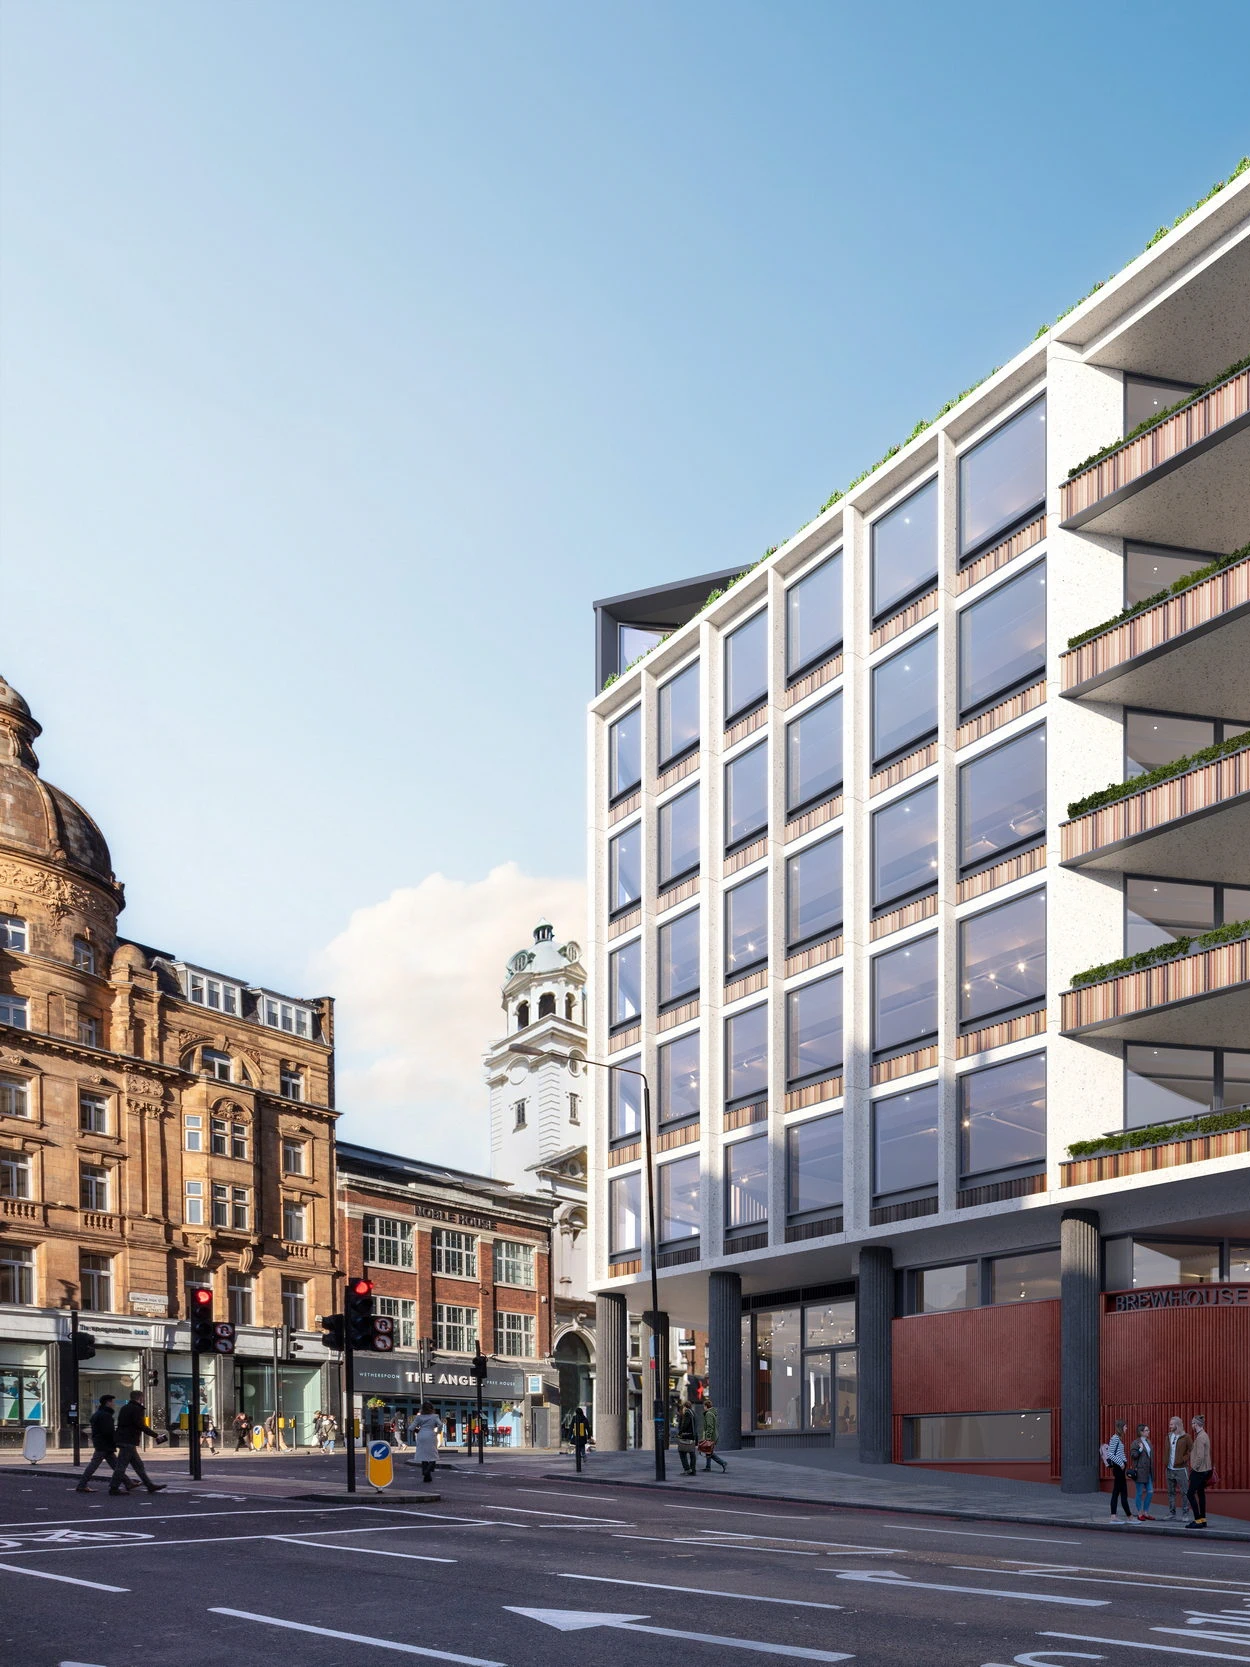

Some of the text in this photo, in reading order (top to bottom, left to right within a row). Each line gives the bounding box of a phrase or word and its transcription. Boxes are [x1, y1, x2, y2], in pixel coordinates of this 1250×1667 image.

[456, 1212, 498, 1231] HOUSE
[1115, 1287, 1249, 1312] BREWHOUSE
[405, 1371, 433, 1383] THE
[438, 1373, 484, 1387] ANGE
